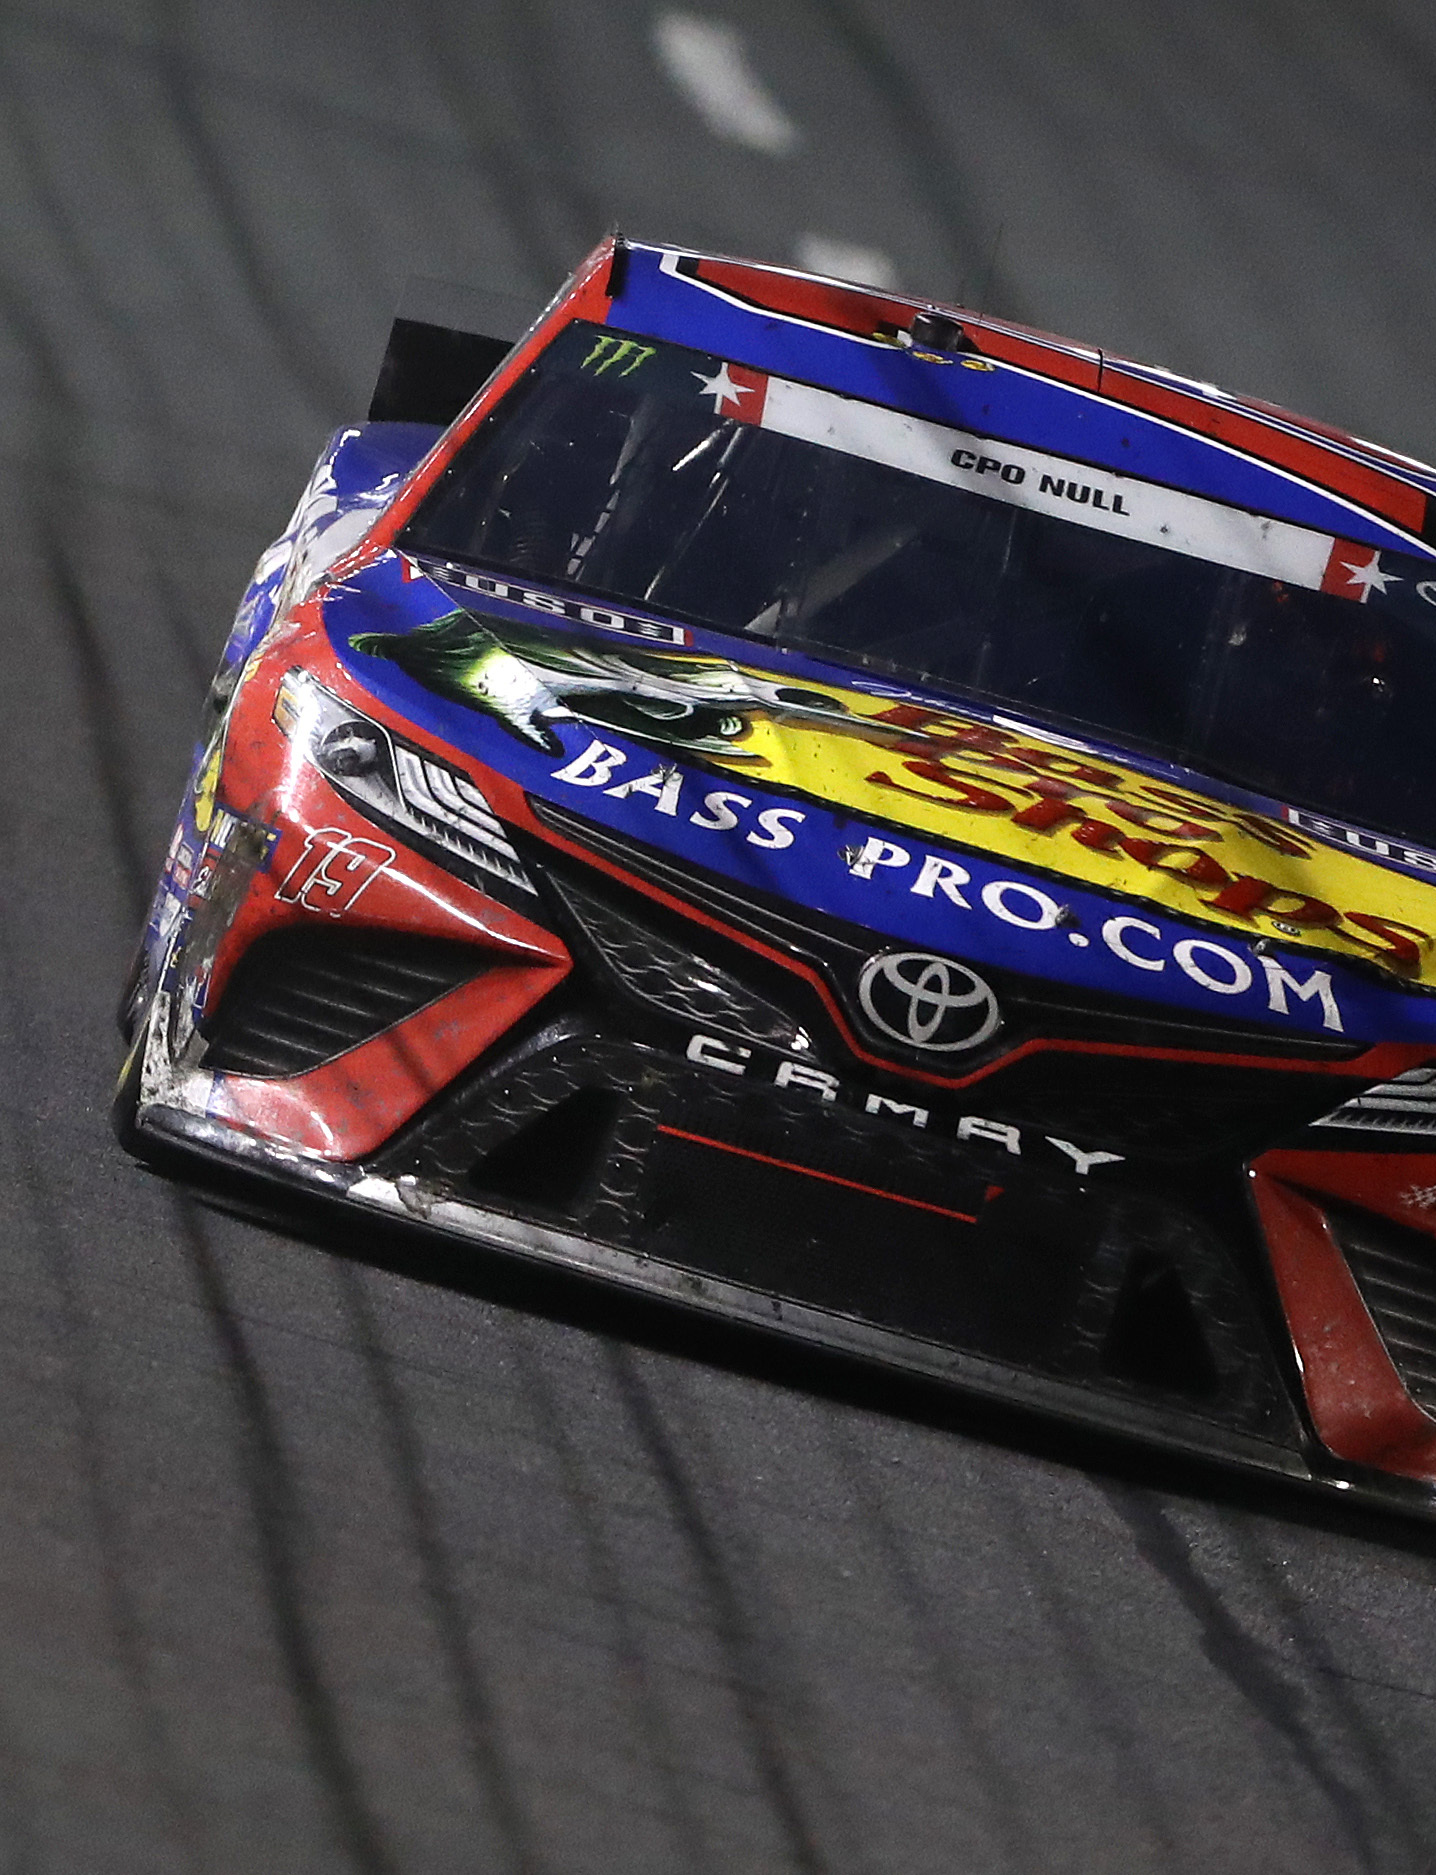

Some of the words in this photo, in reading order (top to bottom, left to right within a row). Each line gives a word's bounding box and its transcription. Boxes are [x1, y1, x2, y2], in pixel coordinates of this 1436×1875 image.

[950, 449, 1026, 485] CPO
[1038, 473, 1131, 517] NULL
[870, 703, 1317, 861] Bass
[274, 827, 397, 918] 19
[550, 738, 807, 850] BASS
[848, 835, 1344, 1033] PRO.COM
[864, 758, 1436, 972] Shops
[685, 1033, 1127, 1176] CAMRY
